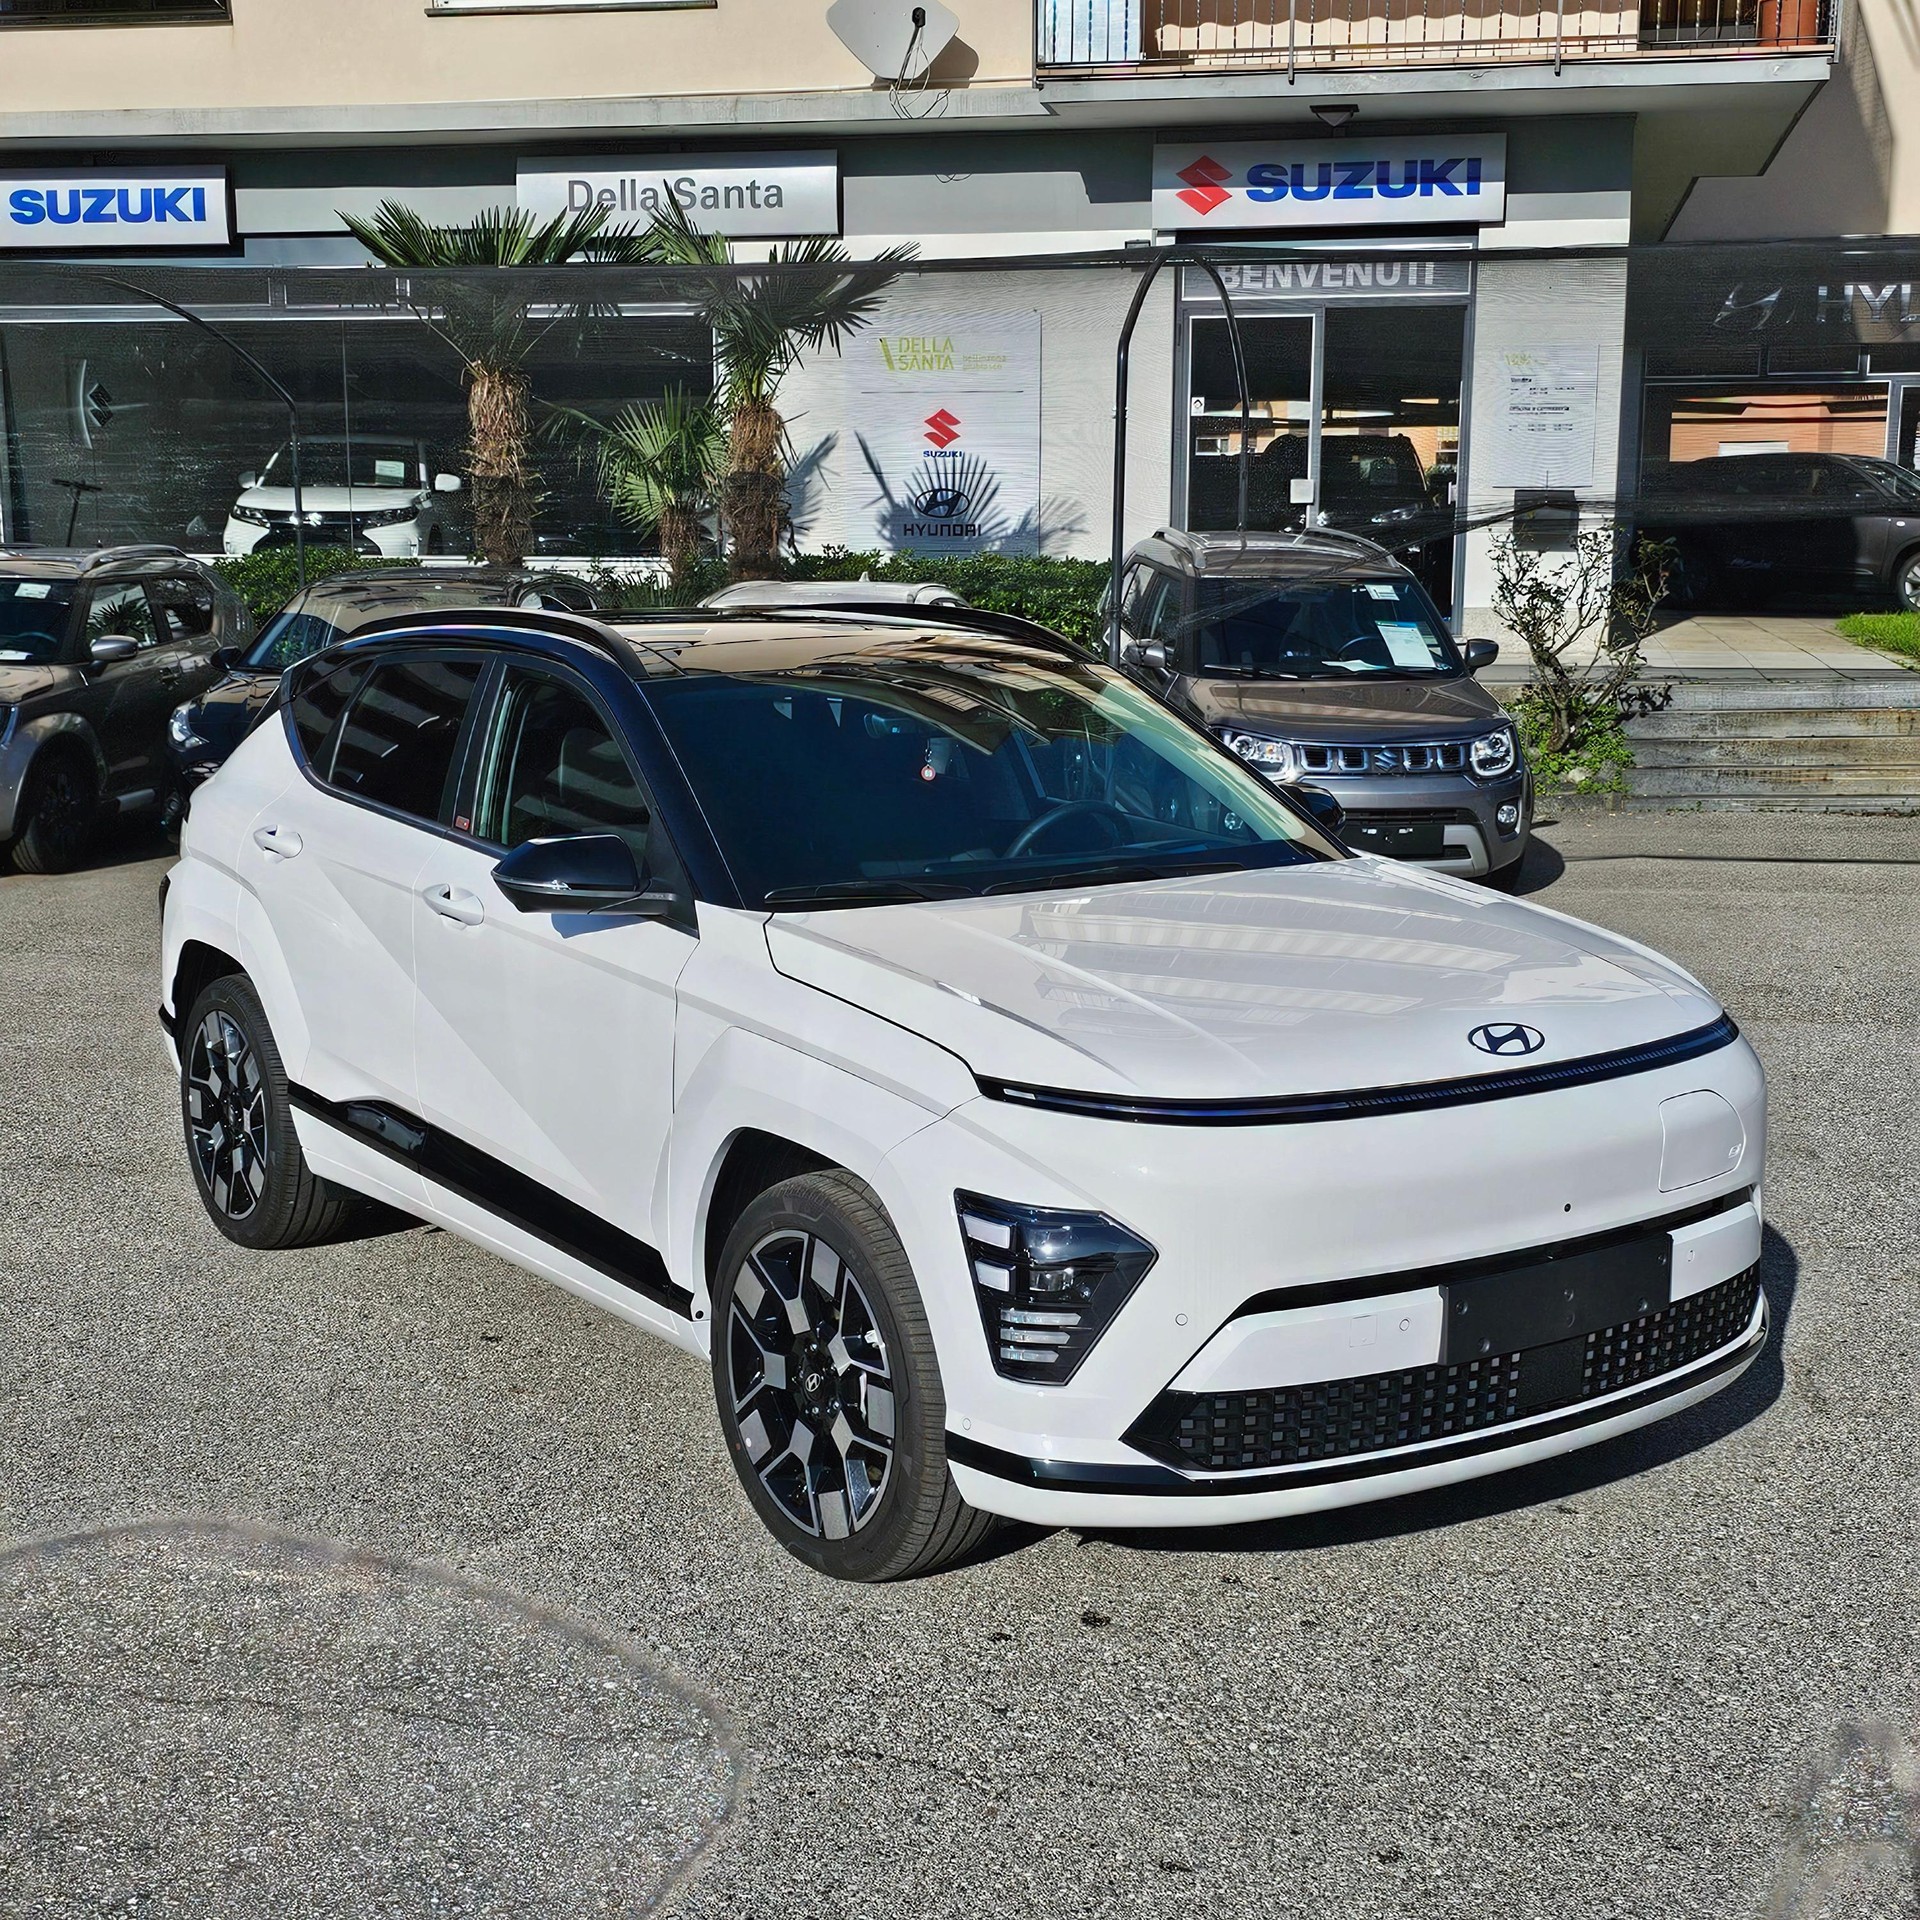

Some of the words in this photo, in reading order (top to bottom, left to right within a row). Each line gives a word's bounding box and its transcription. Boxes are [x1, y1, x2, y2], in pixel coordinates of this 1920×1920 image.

[1246, 157, 1482, 203] SUZUKI
[568, 178, 659, 212] Della
[673, 176, 784, 211] Santa
[9, 187, 206, 225] SUZUKI
[898, 336, 955, 353] DELLA
[898, 354, 955, 371] SANTA
[923, 450, 963, 458] SUZUKI
[903, 523, 982, 537] HYUNDAI
